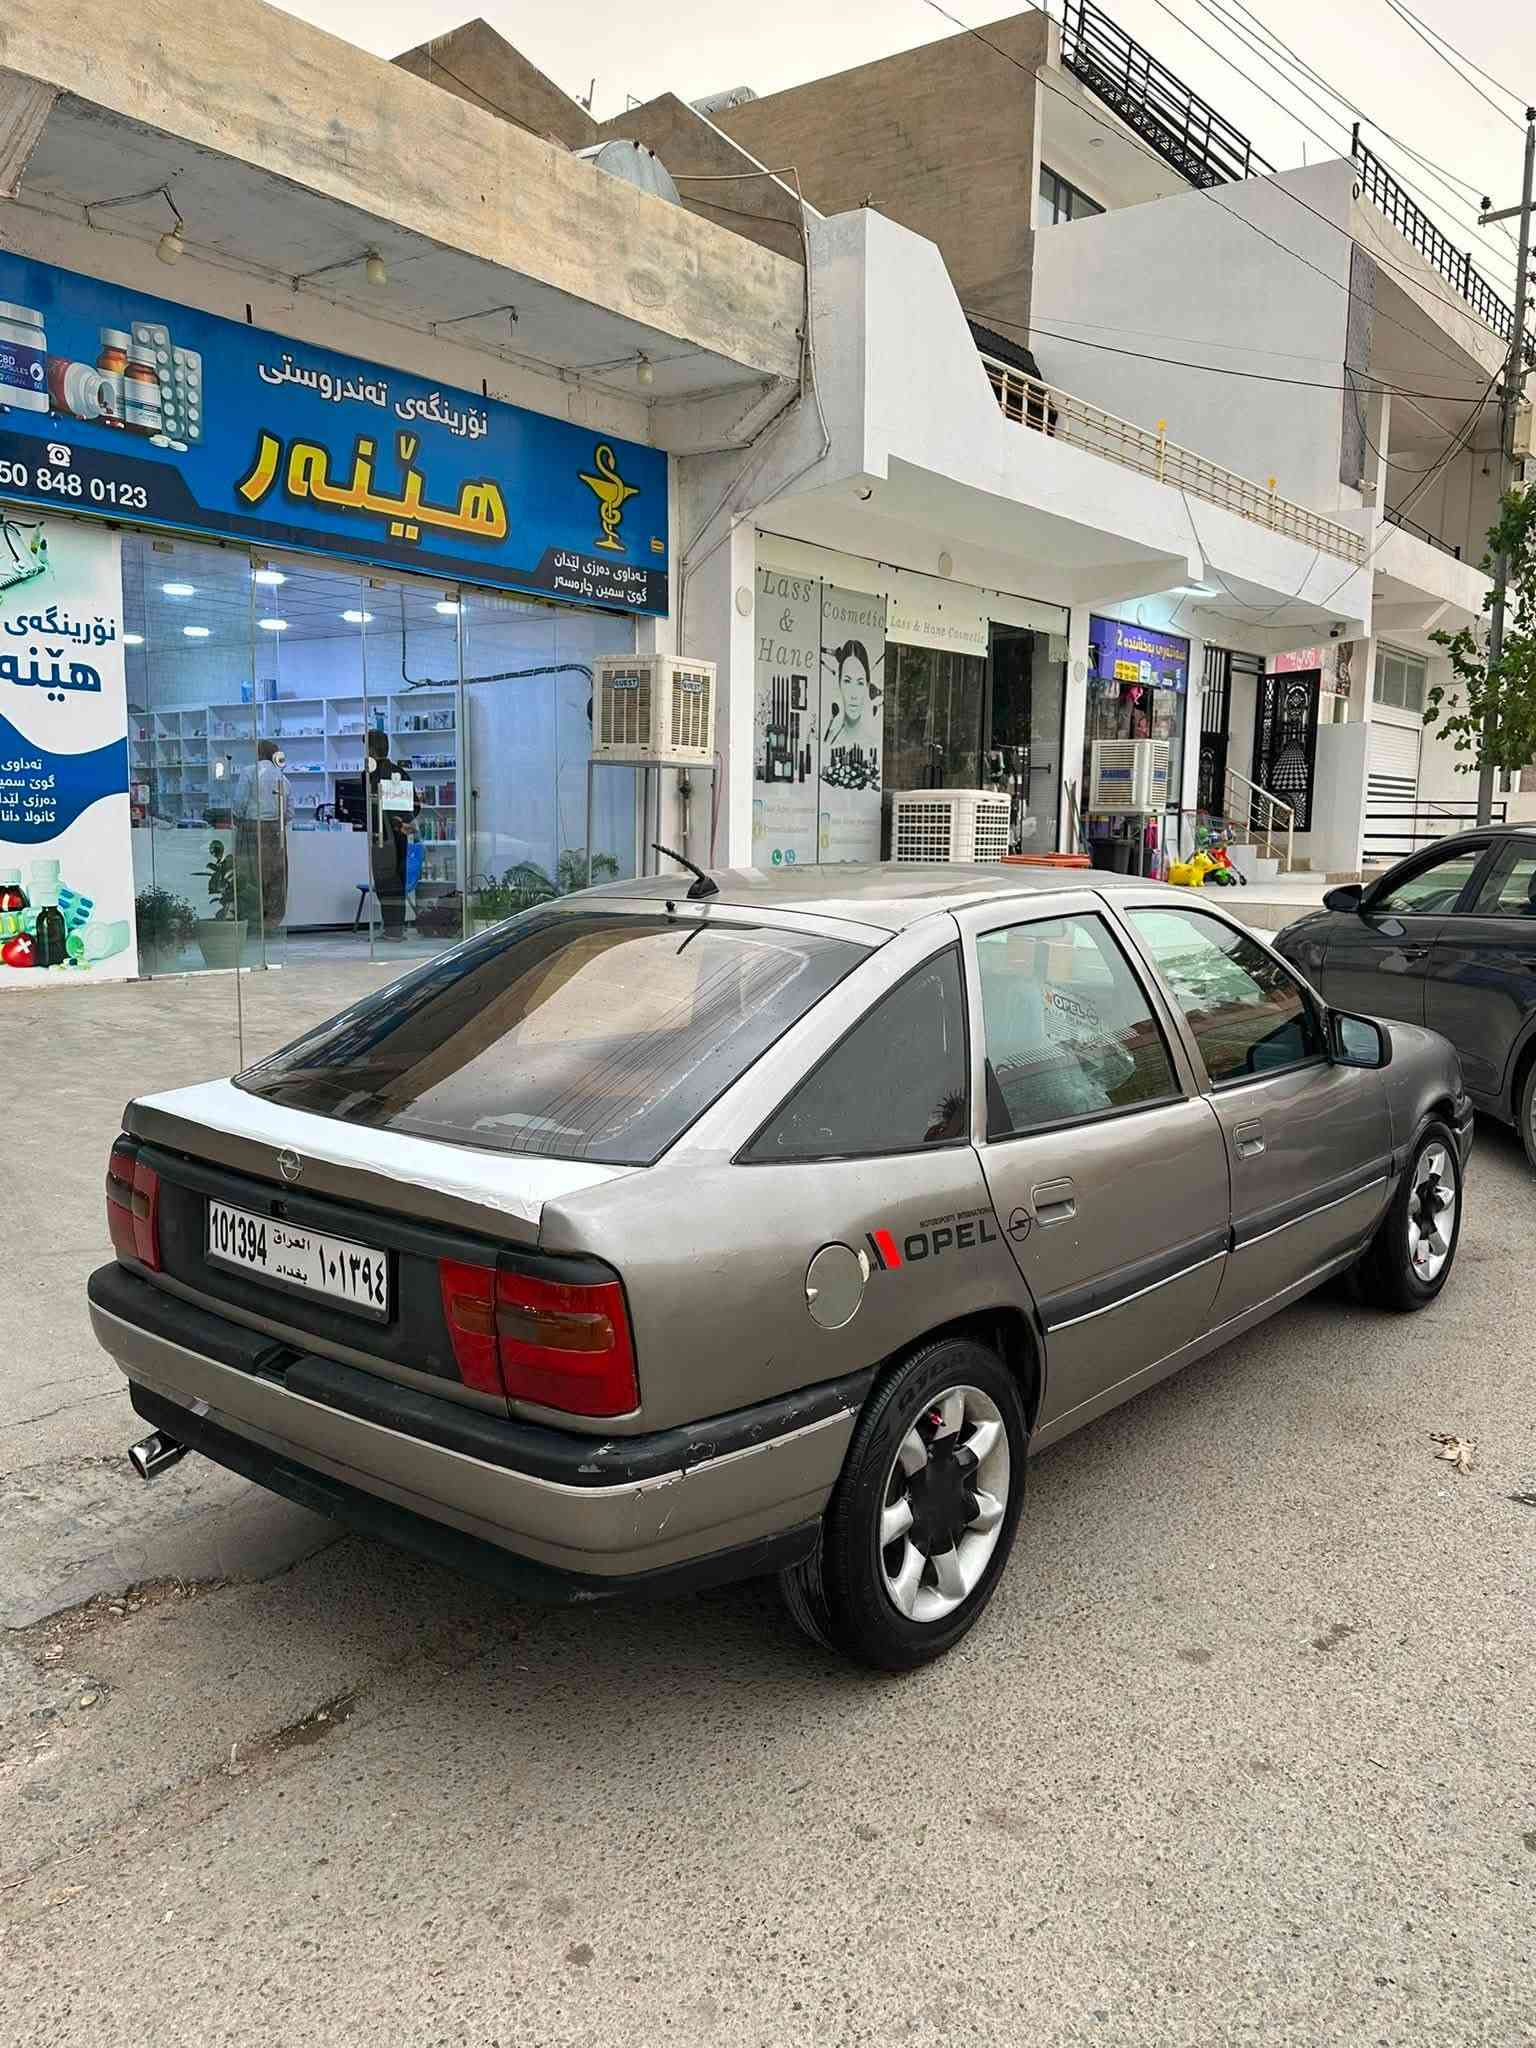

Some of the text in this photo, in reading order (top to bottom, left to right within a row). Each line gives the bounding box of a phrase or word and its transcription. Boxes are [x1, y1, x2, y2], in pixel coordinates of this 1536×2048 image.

[258, 353, 488, 438] نۆرینگەی تەندروستی
[36, 467, 82, 497] 848
[90, 478, 148, 508] 0123
[239, 435, 507, 540] هێنەر
[553, 551, 648, 583] تەداوی دەرزی لێدان
[553, 574, 593, 597] چارەسەر
[626, 586, 648, 604] گوێ
[762, 570, 812, 603] Lass
[4, 605, 116, 645] نۆرینگەی
[779, 607, 795, 633] &
[823, 600, 886, 630] Cosmetic
[758, 637, 815, 669] Hane
[1, 756, 43, 773] تەداوی
[29, 774, 56, 791] گوێ
[22, 793, 57, 808] دەرزی
[212, 1207, 267, 1266] 101394
[273, 1229, 311, 1250] العراق
[904, 1219, 997, 1262] OPEL
[276, 1263, 308, 1285] بغداد
[319, 1244, 385, 1305] ١٠١٣٩٤
